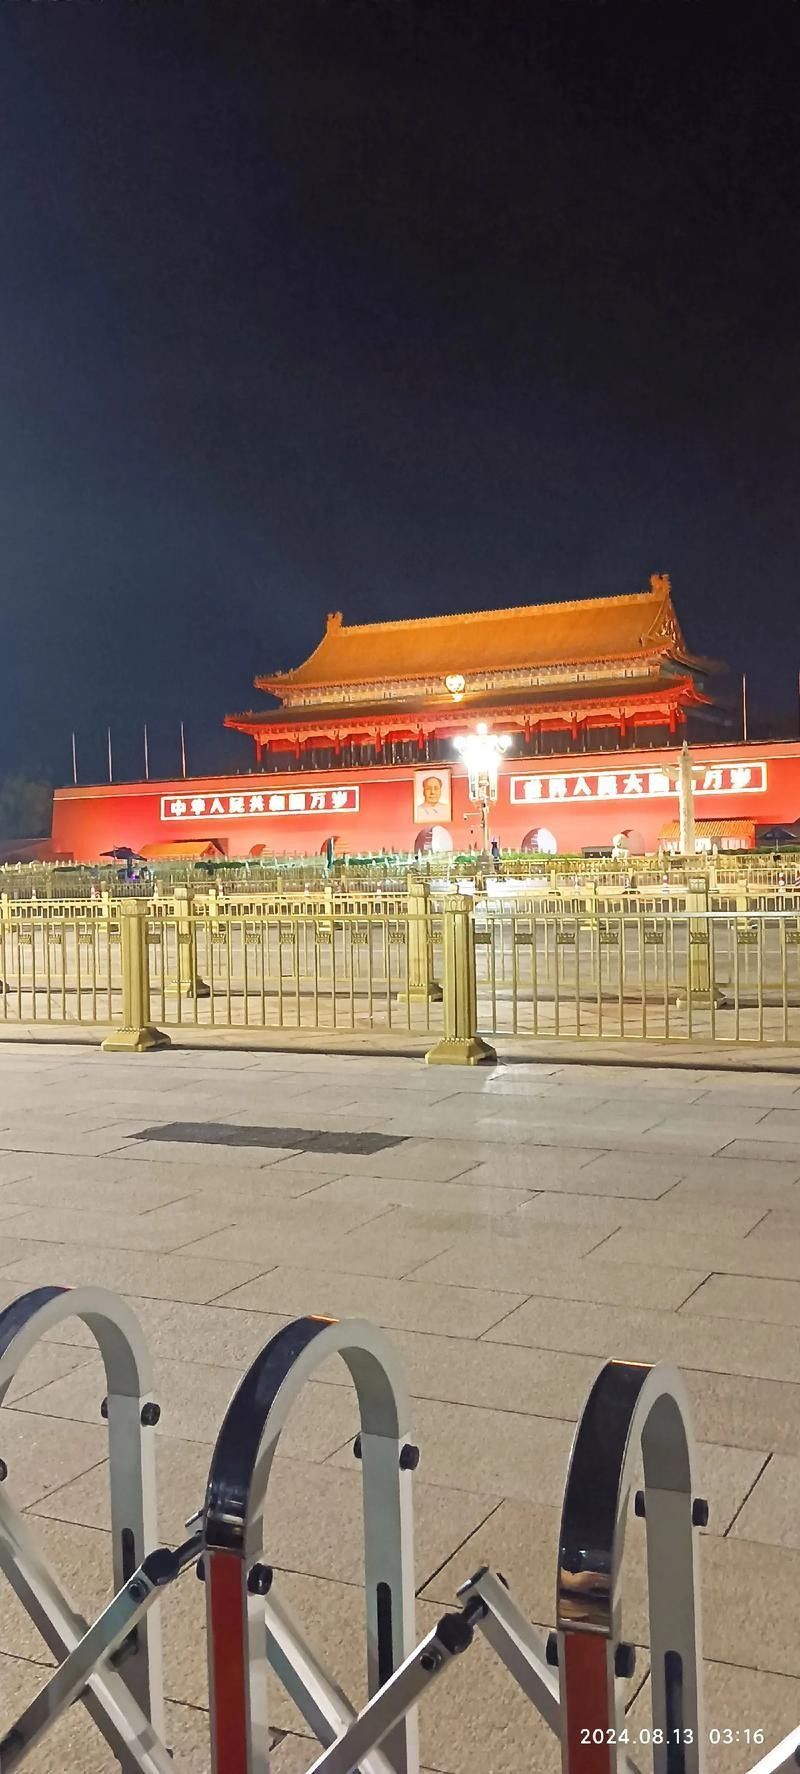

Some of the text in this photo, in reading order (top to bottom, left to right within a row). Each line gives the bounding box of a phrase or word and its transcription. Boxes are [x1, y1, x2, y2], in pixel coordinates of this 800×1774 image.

[523, 768, 751, 799] 世界人民大团万岁
[170, 791, 348, 816] 中华人民共和国万岁
